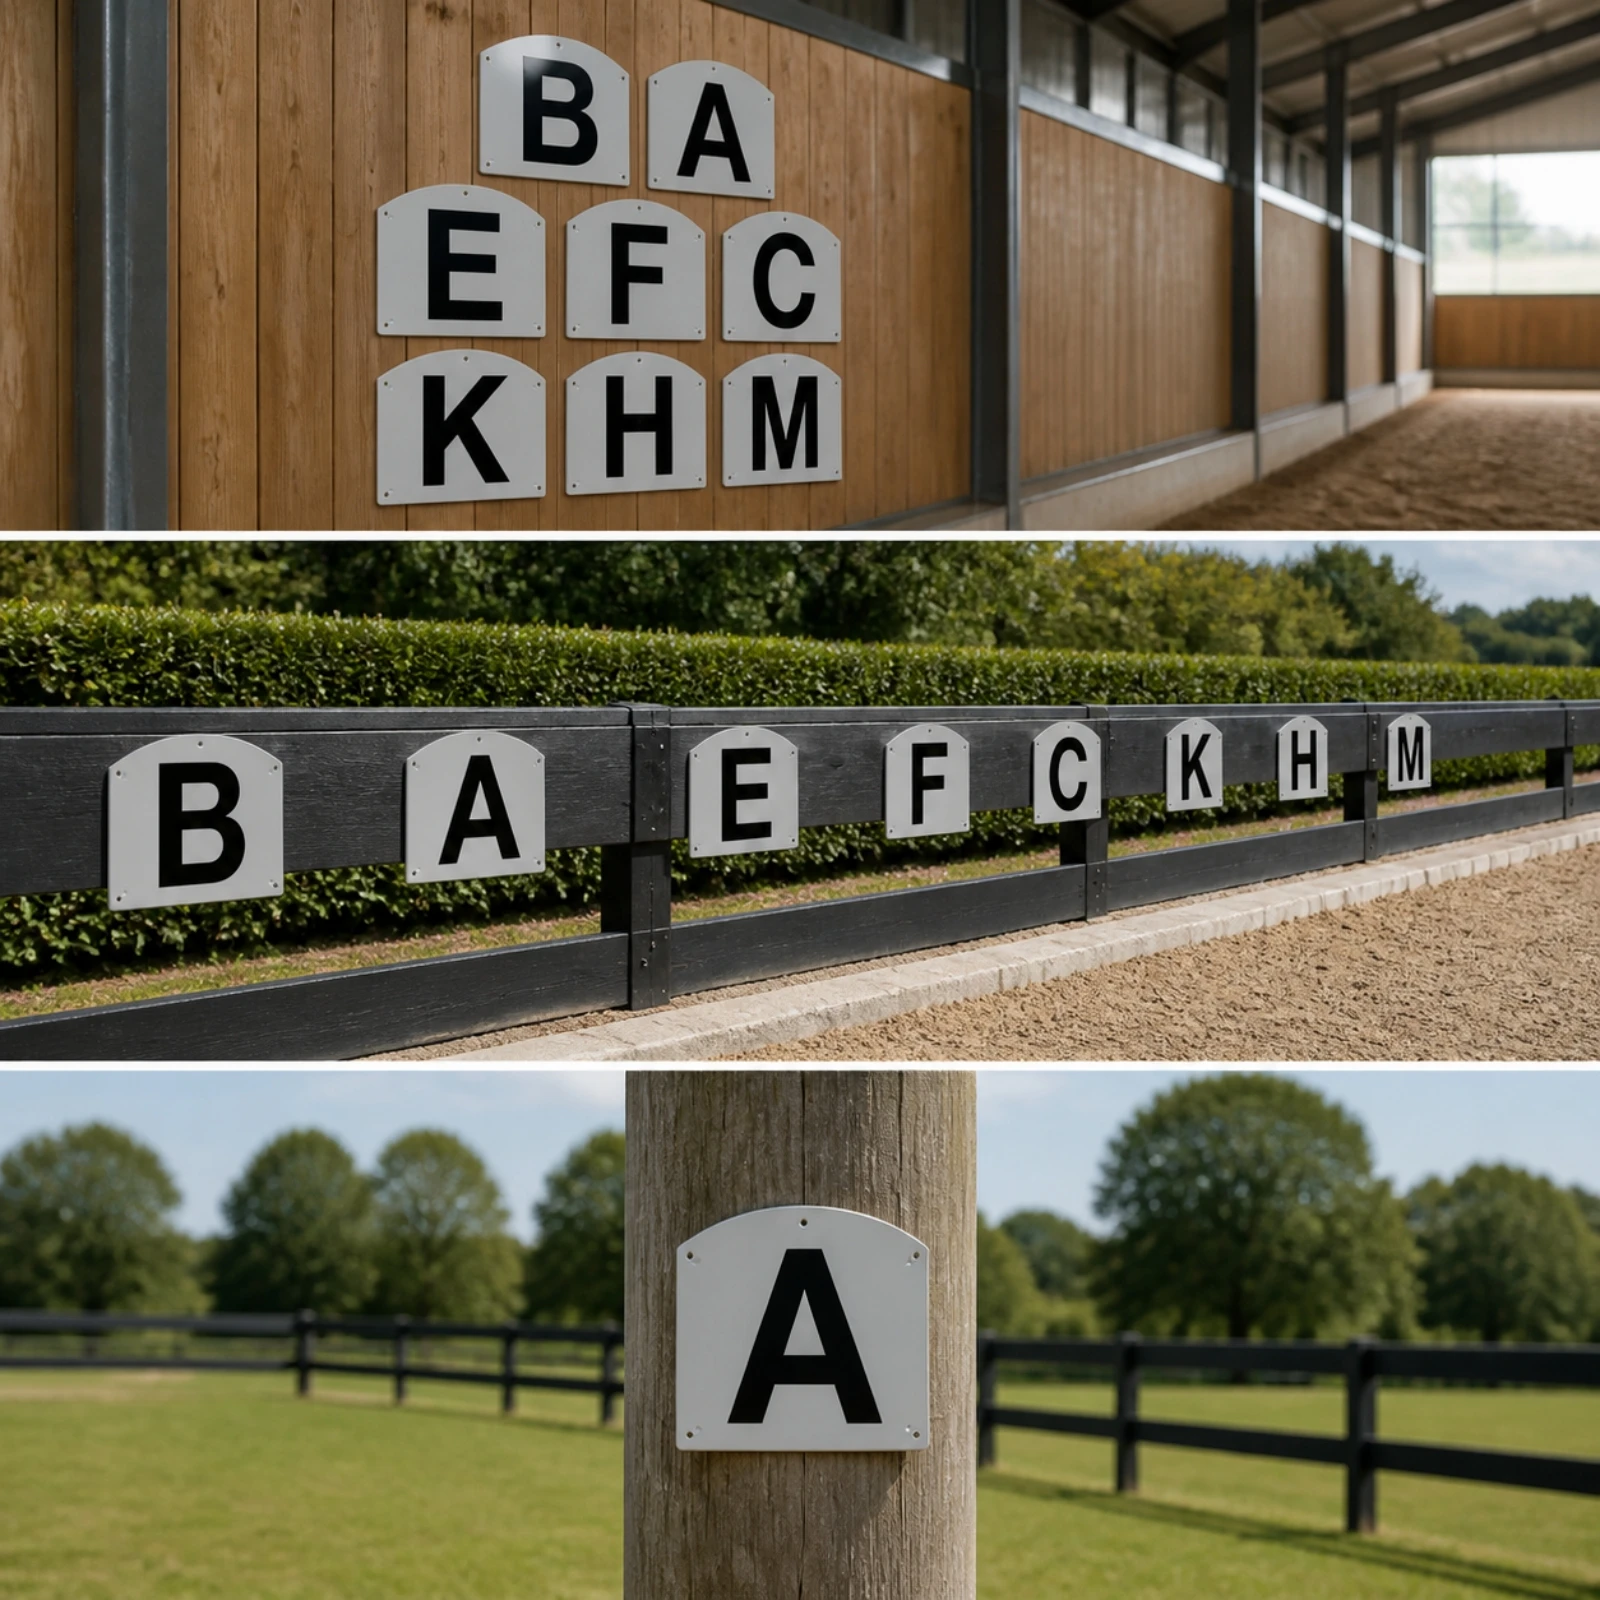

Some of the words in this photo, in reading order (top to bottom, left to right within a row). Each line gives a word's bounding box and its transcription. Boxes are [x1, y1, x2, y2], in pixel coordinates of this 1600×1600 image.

[522, 56, 598, 166] B
[677, 82, 751, 182] A
[428, 209, 503, 321] E
[611, 223, 668, 324] F
[753, 232, 815, 329] C
[423, 375, 509, 486] K
[606, 376, 673, 478] H
[752, 376, 818, 471] M
[722, 748, 772, 842] E
[912, 742, 947, 825] F
[1050, 737, 1087, 812] C
[1182, 734, 1212, 800] K
[1292, 730, 1317, 789] H
[1398, 726, 1423, 782] M
[159, 762, 245, 888] B
[439, 755, 520, 865] A
[727, 1249, 882, 1424] A
